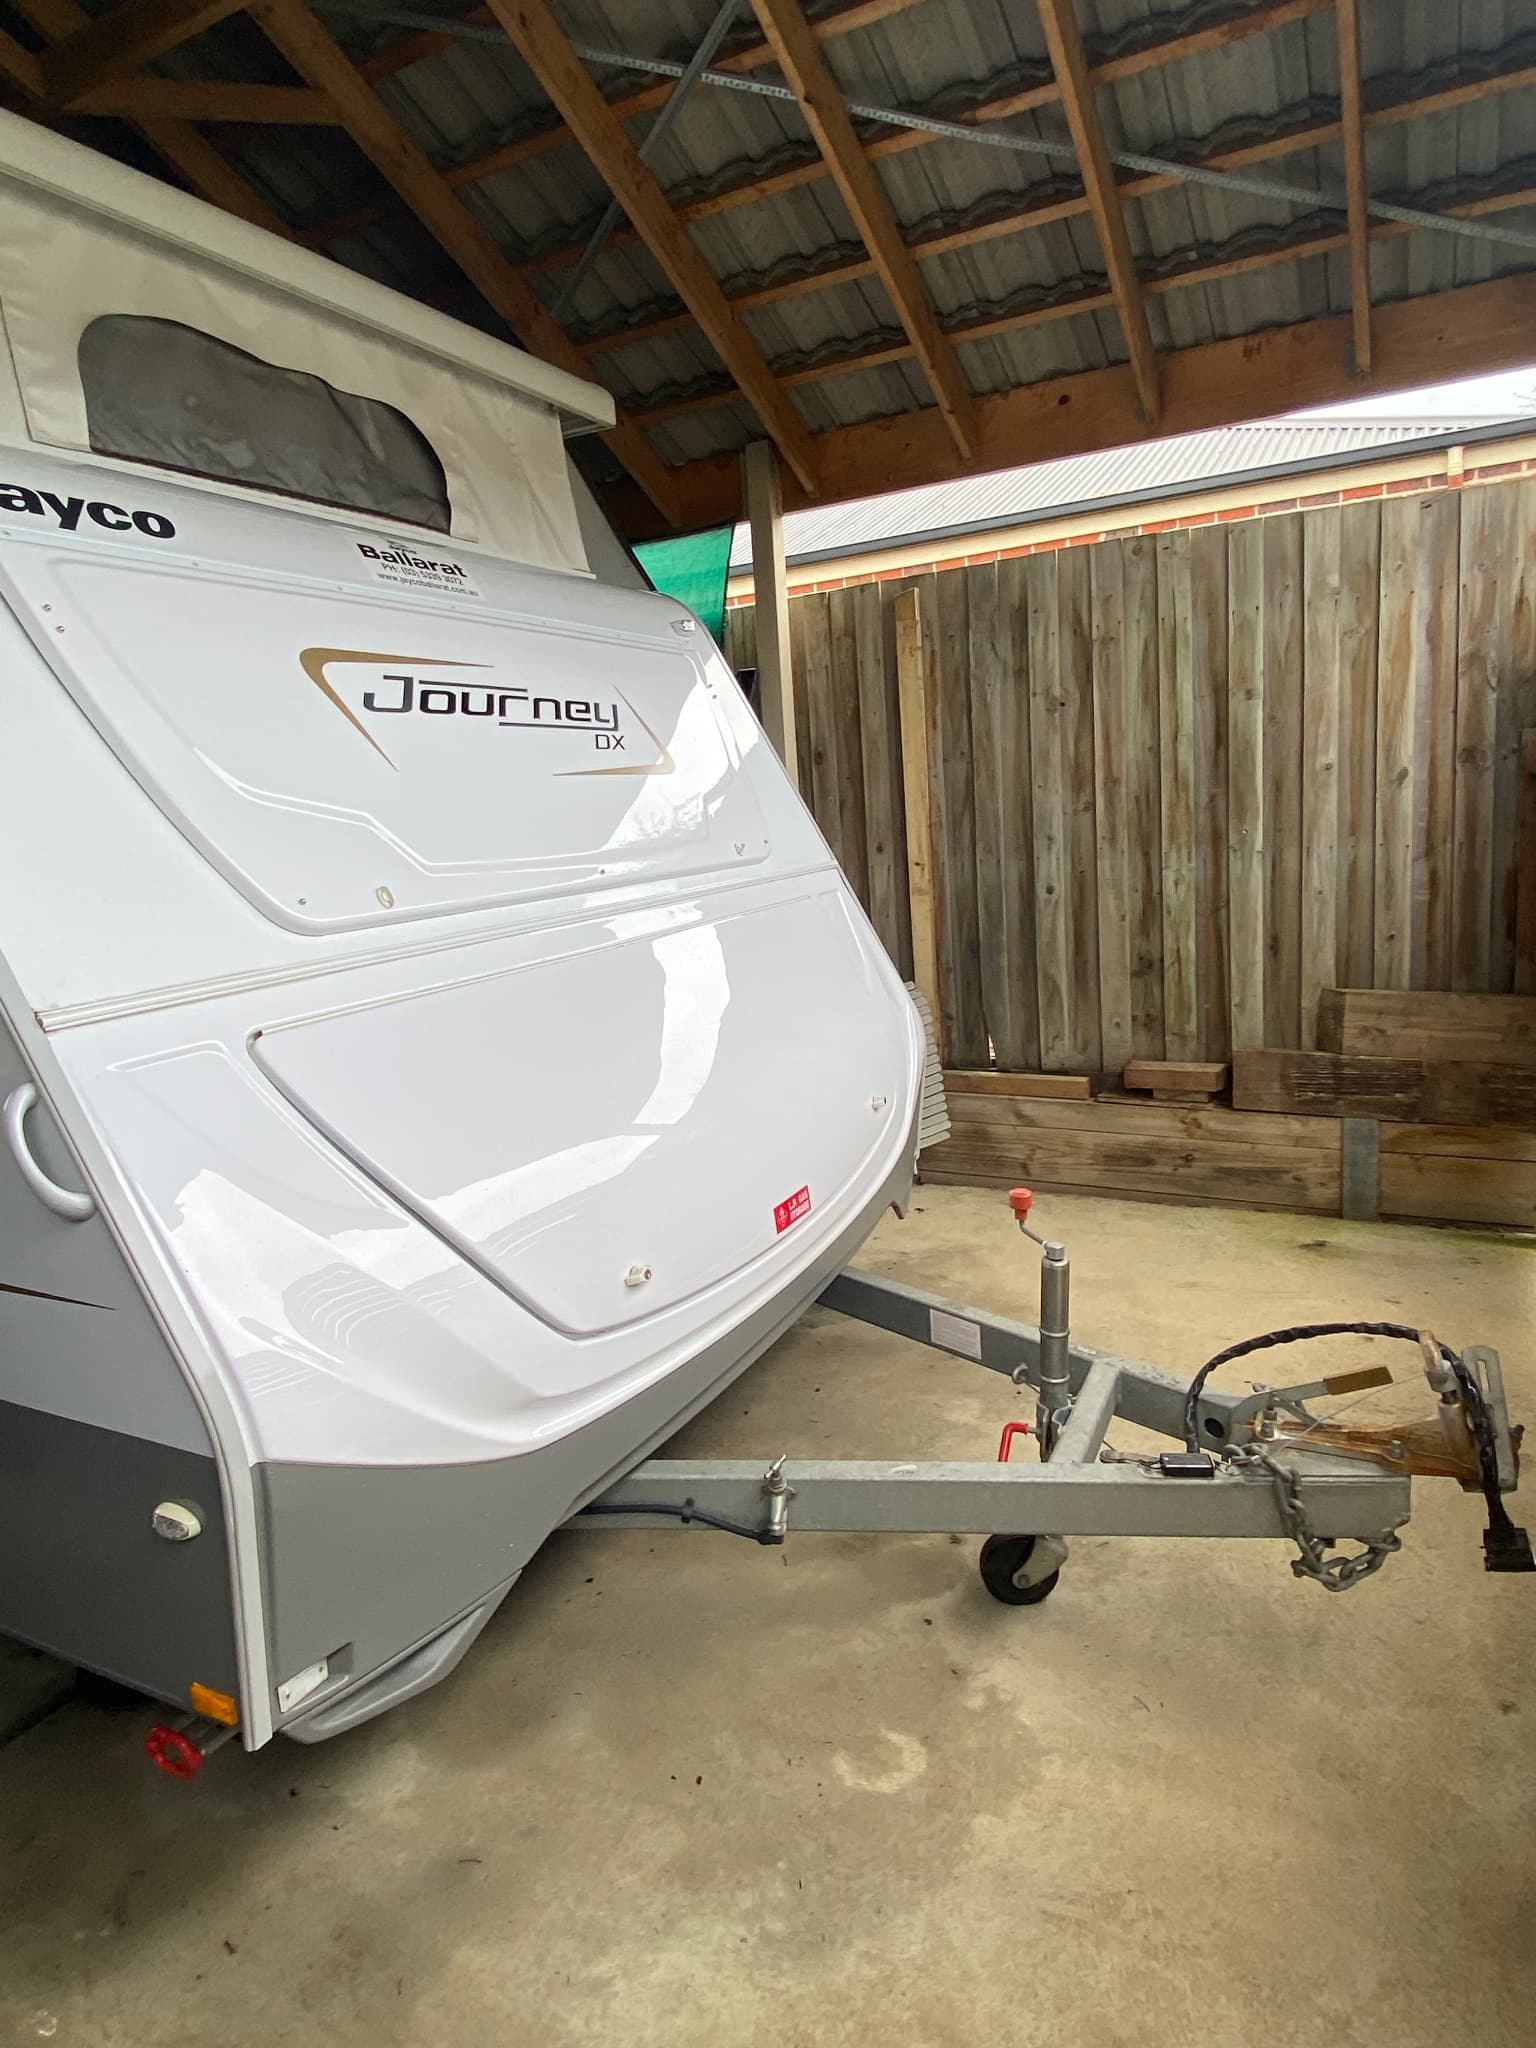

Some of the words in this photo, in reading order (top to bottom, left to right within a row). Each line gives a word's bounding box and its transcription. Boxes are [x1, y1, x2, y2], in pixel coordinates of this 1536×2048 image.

[356, 543, 467, 578] Ballarat
[363, 674, 618, 731] Journey
[595, 733, 625, 750] DX
